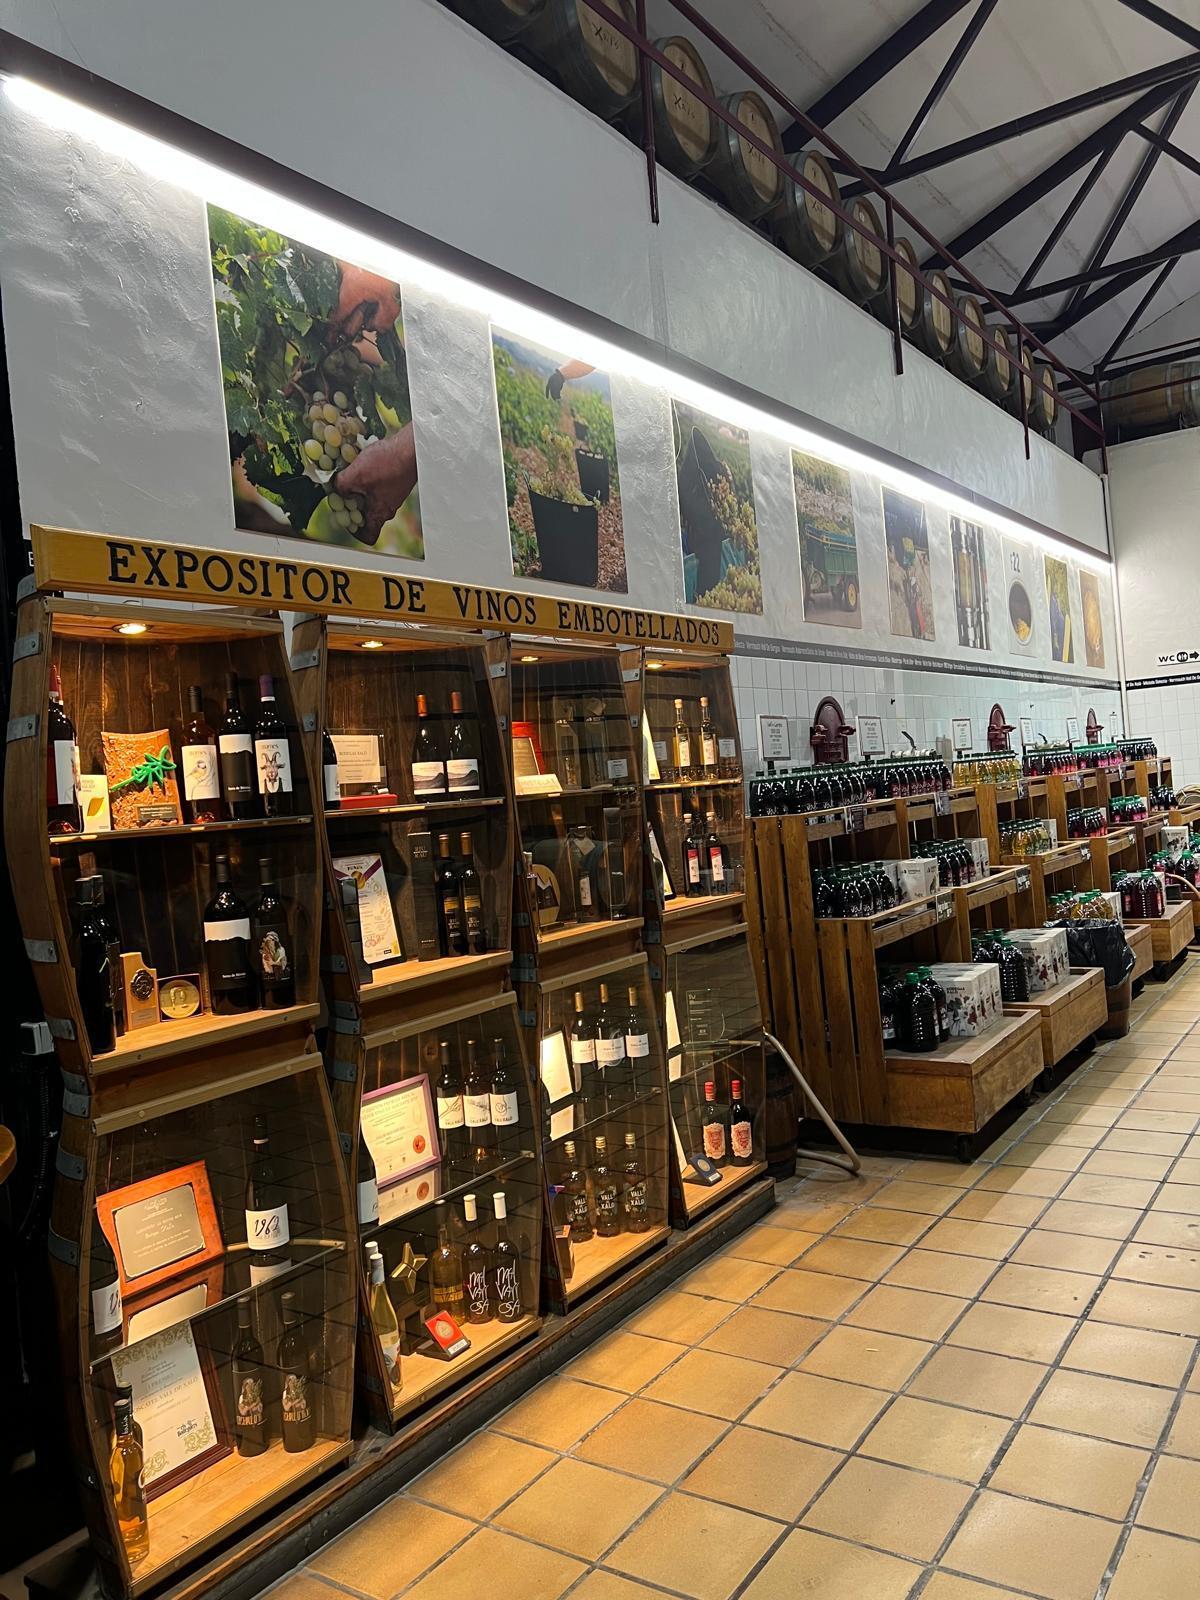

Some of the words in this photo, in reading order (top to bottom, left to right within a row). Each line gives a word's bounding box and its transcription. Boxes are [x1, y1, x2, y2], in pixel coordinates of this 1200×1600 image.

[106, 540, 353, 605] EXPOSITOR
[382, 576, 426, 613] DE
[452, 586, 537, 626] VINOS
[557, 601, 720, 646] EMBOTELLADOS
[1158, 655, 1175, 663] WC
[600, 1193, 614, 1201] VALL
[630, 1190, 643, 1198] VALL
[574, 1197, 586, 1206] VALL
